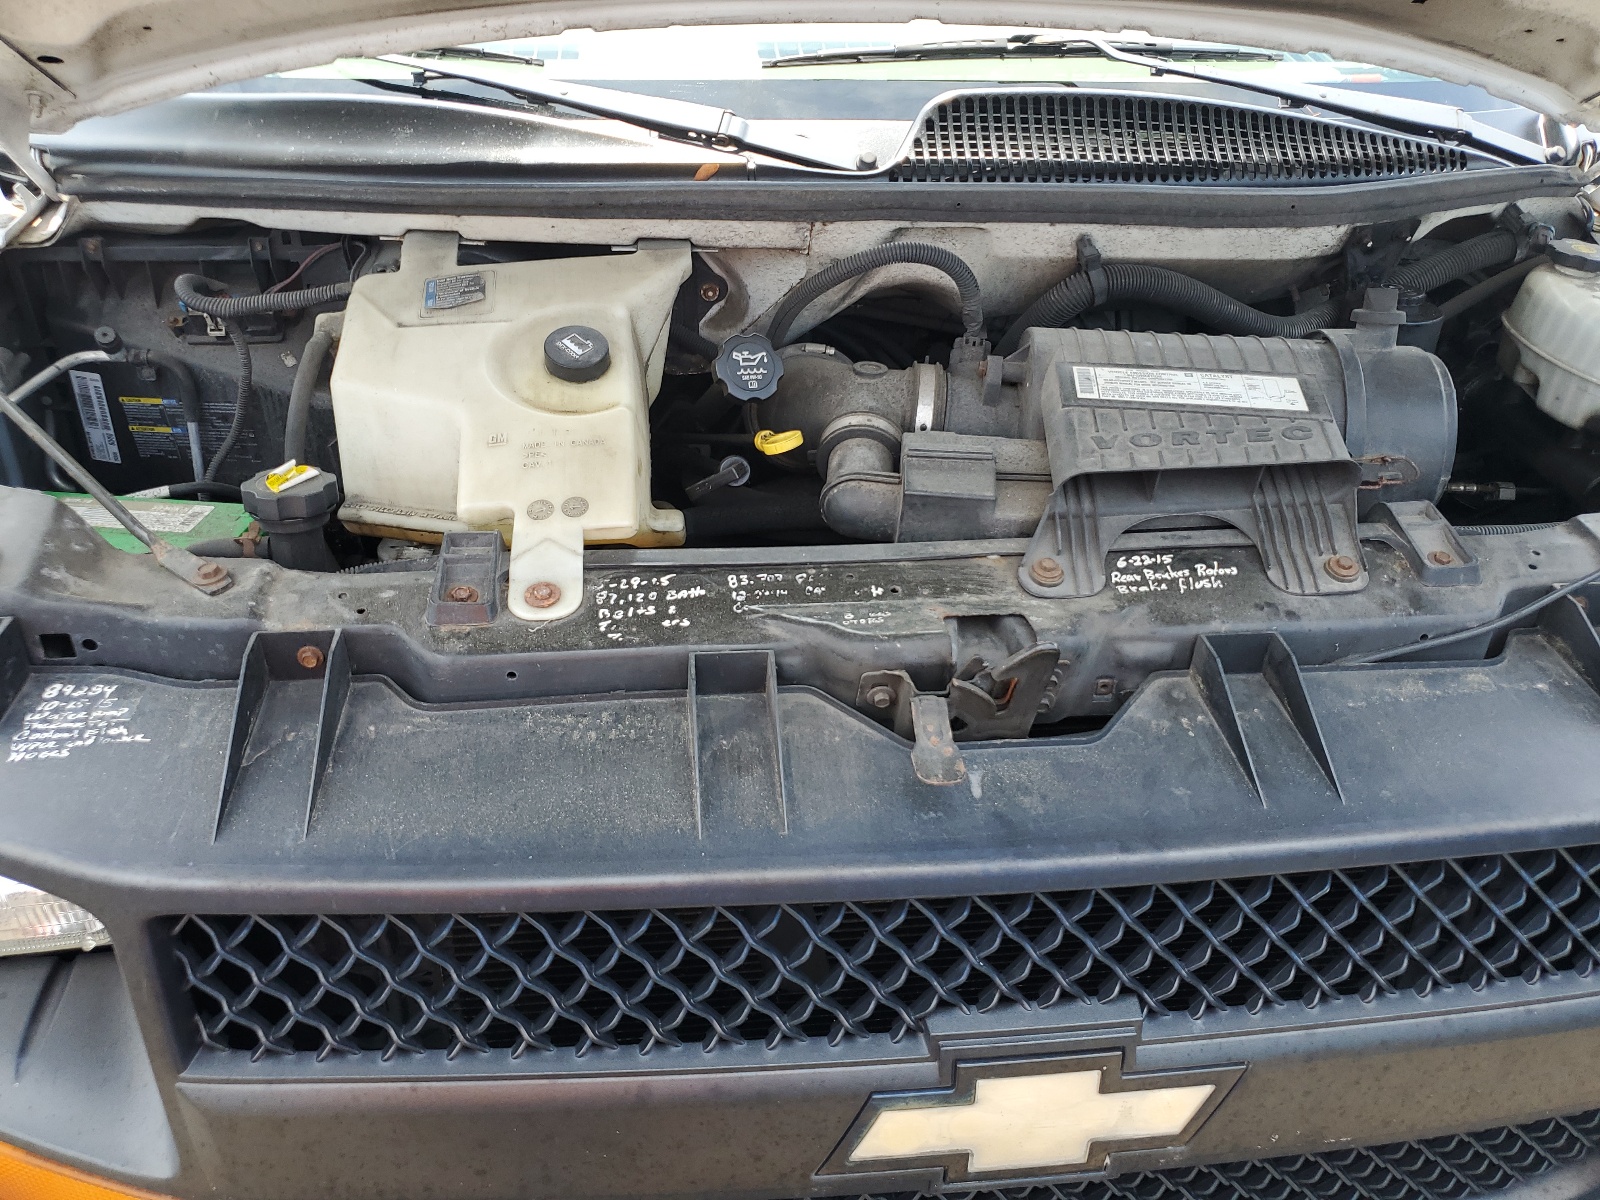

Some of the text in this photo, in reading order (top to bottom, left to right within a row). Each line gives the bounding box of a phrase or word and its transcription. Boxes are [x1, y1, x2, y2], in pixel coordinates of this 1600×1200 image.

[570, 438, 606, 447] CANADA
[1090, 425, 1314, 450] VORTEC
[1116, 554, 1174, 568] 6-22-15
[1111, 571, 1142, 583] Rear
[1143, 565, 1190, 580] Brakes
